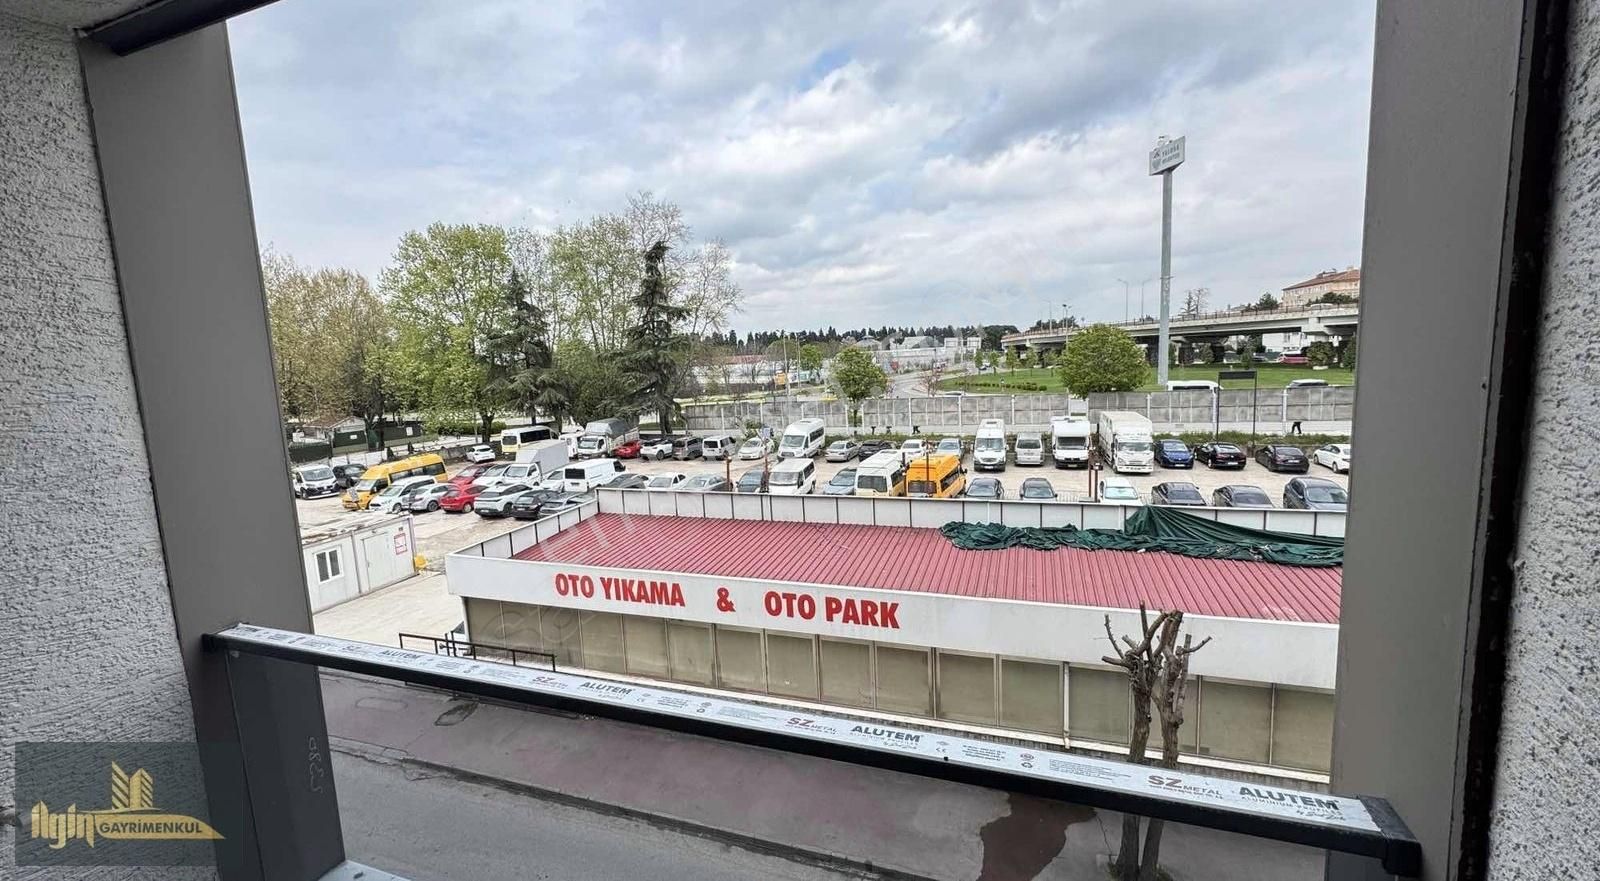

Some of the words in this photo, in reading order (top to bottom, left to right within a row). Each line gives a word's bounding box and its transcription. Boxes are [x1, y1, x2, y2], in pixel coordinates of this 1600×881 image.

[555, 573, 595, 599] OTO
[600, 576, 686, 607] YIKAMA
[716, 587, 735, 613] &
[764, 590, 816, 620] OTO
[826, 597, 900, 629] PARK
[581, 681, 633, 695] ALUTEM
[787, 717, 815, 728] SZ
[851, 725, 921, 743] ALUTEM
[1147, 775, 1183, 789] SZ
[1182, 785, 1224, 797] METAL
[1239, 786, 1341, 811] ALUTEM
